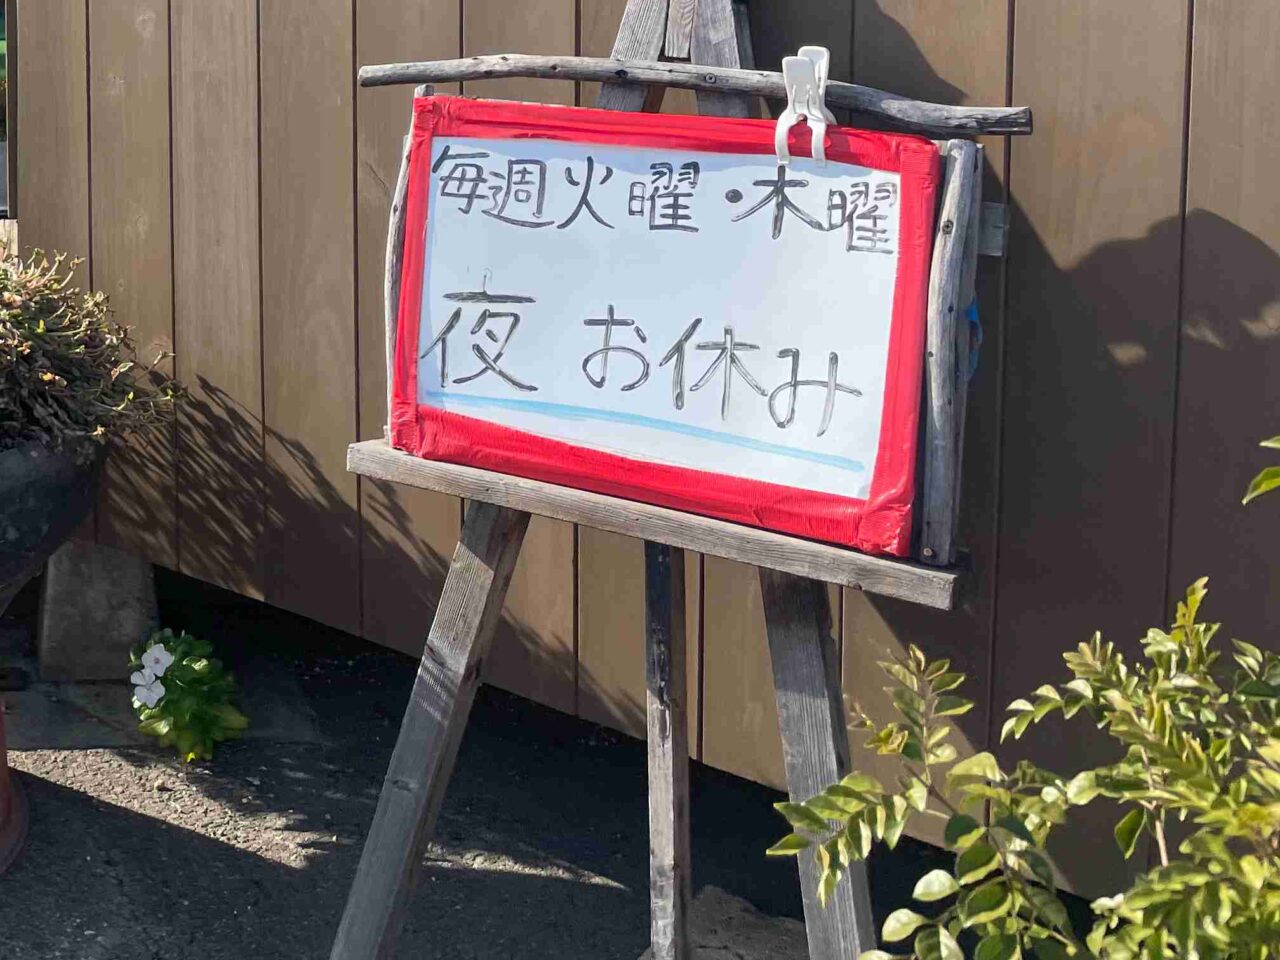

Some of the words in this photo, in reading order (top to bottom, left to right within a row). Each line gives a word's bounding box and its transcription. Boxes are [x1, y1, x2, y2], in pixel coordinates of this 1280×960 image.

[420, 276, 539, 392] 夜
[582, 303, 864, 437] お休み
